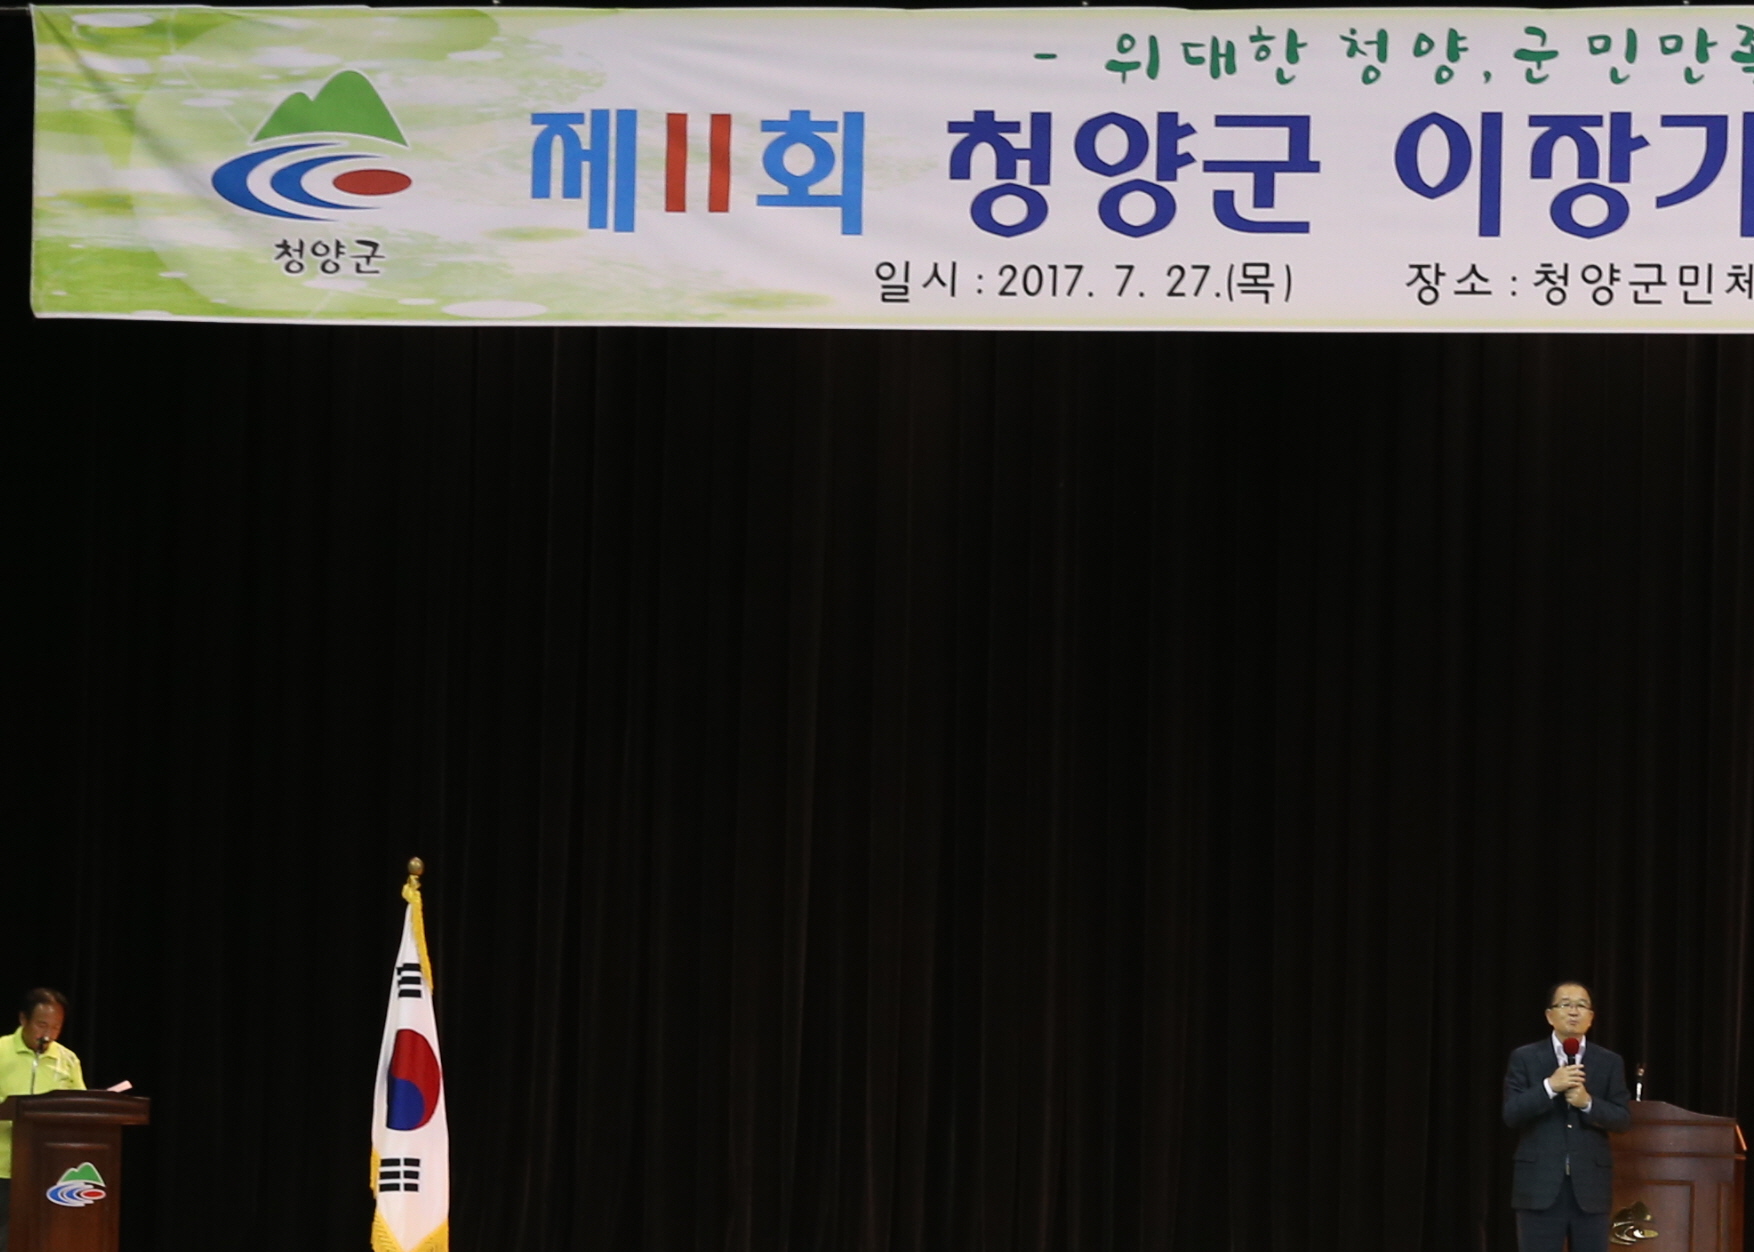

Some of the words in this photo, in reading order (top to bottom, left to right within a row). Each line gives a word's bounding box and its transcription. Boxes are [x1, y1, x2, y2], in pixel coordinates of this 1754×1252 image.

[1105, 26, 1308, 85] 위대한
[529, 108, 864, 237] 제11회
[947, 109, 1322, 239] 청양군
[273, 239, 386, 275] 청양군
